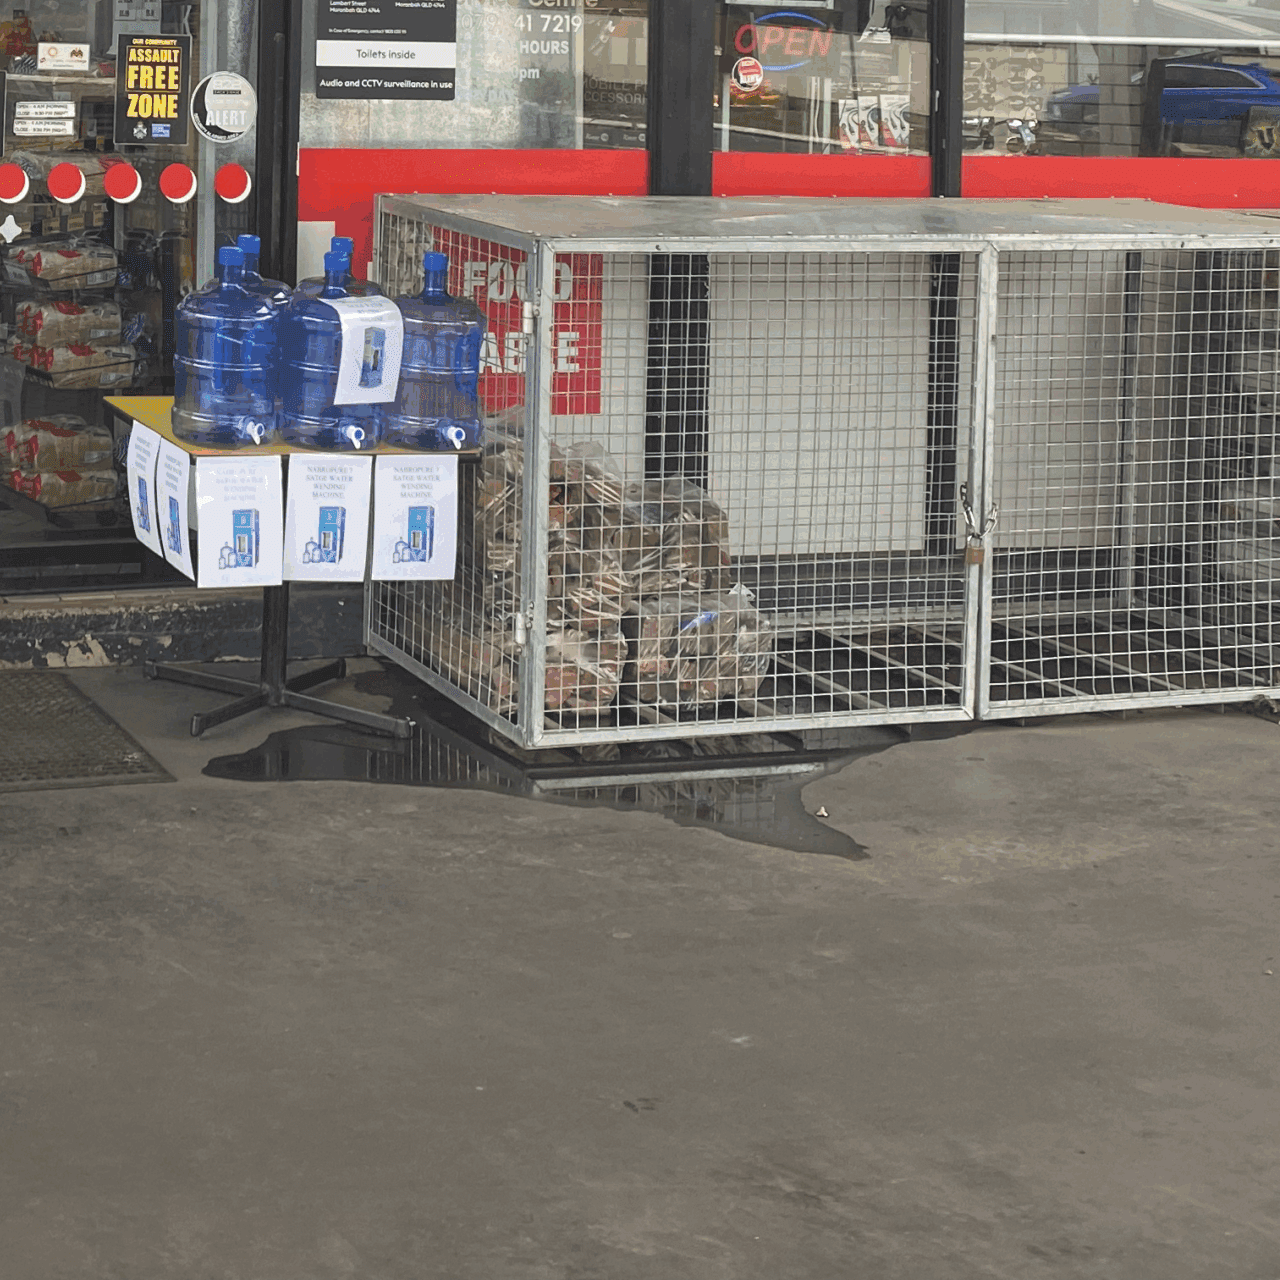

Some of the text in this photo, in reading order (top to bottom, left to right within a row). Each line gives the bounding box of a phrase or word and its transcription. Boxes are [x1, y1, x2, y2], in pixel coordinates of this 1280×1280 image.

[540, 14, 583, 33] 7219
[520, 40, 569, 54] HOURS
[734, 23, 833, 57] OPEN
[129, 48, 179, 63] ASSAULT
[357, 49, 386, 58] Toilets
[128, 65, 179, 89] FREE
[320, 79, 343, 87] Audio
[344, 79, 360, 87] and
[361, 80, 383, 88] CCTV
[383, 80, 429, 88] surveillance
[127, 94, 178, 118] ZONE
[206, 110, 246, 126] ALERT
